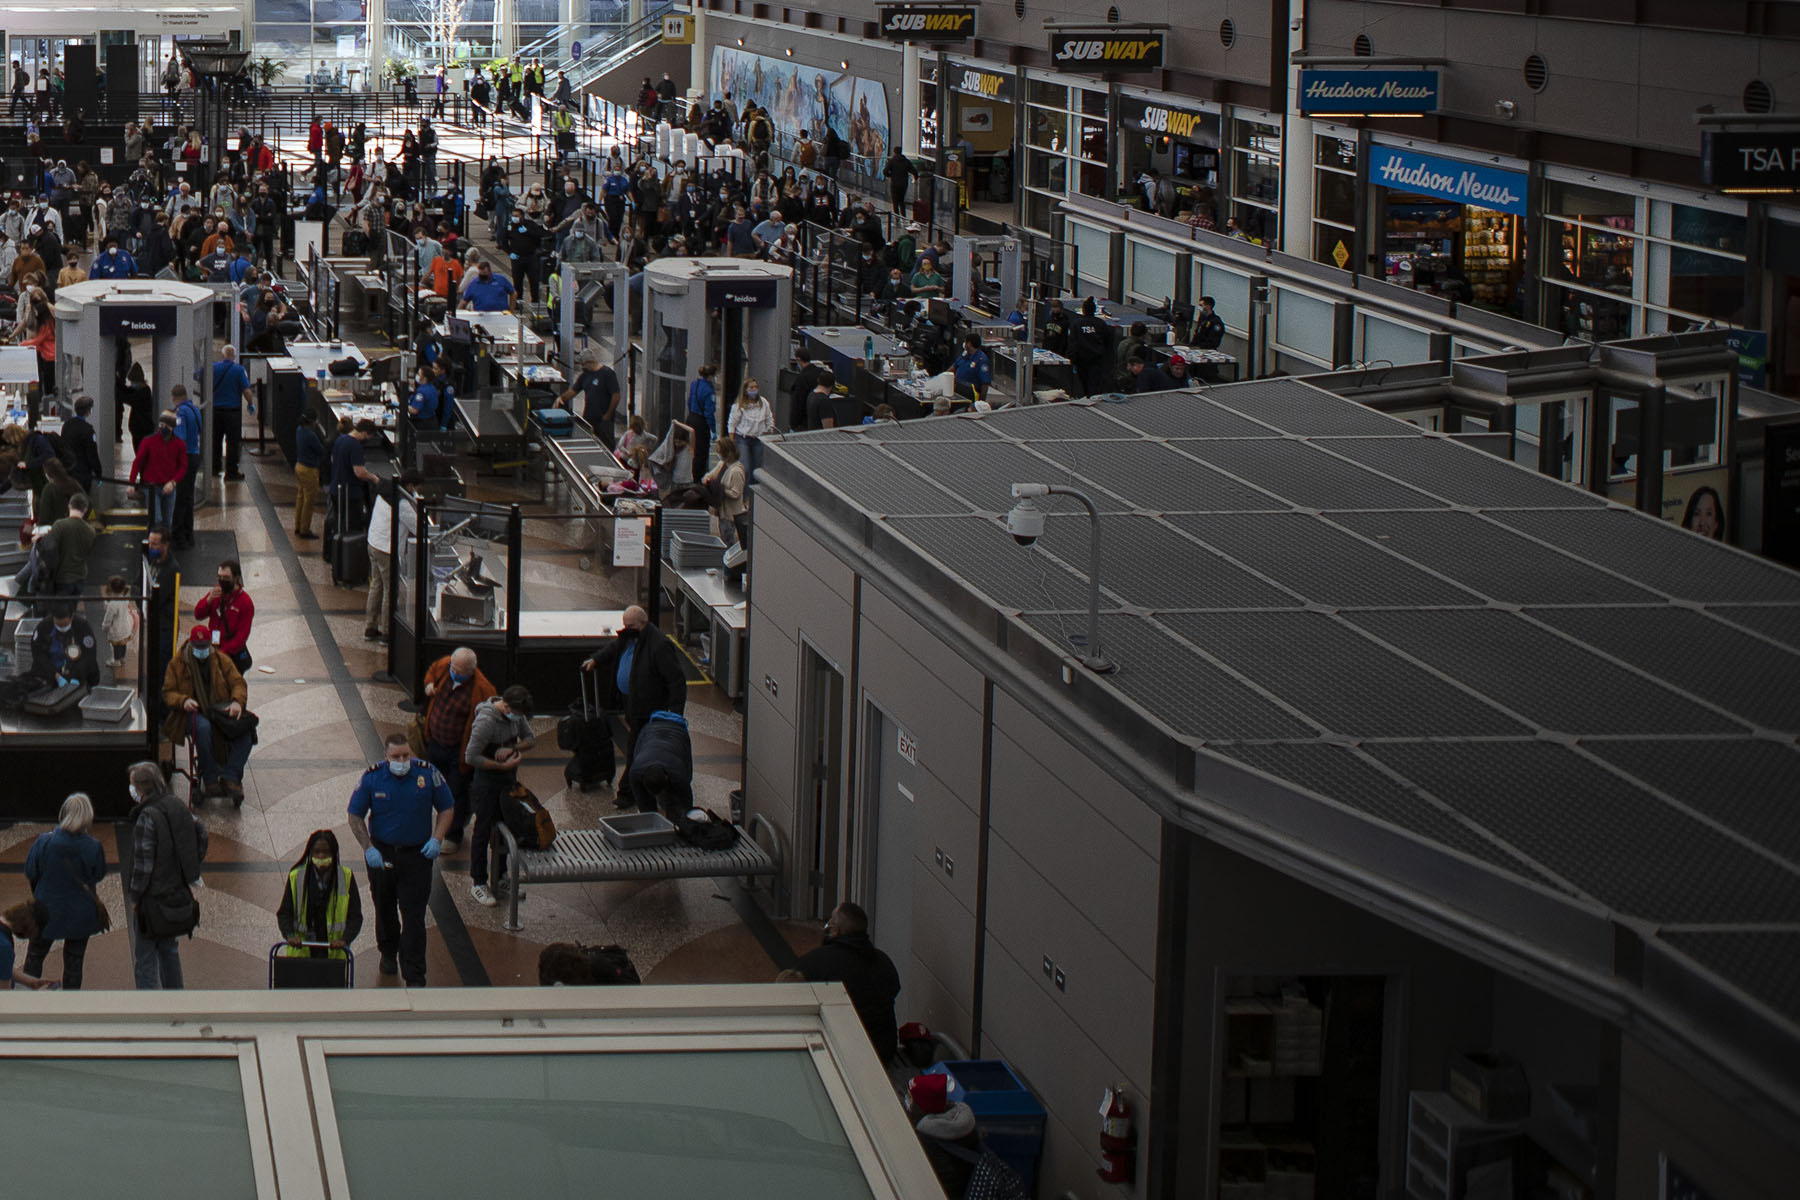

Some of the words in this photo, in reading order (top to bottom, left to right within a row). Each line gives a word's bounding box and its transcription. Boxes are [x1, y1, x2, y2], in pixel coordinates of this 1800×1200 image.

[884, 13, 973, 31] SUBWAY
[1056, 40, 1160, 60] SUBWAY
[961, 70, 1004, 96] SUBWAY
[1305, 80, 1378, 98] Hudson
[1377, 81, 1435, 98] News
[1139, 106, 1201, 137] SUBWAY
[1737, 147, 1785, 171] TSA
[1380, 155, 1454, 193] Hudson
[1455, 171, 1520, 205] News
[734, 295, 758, 303] leidos
[131, 321, 156, 330] leidos
[1081, 326, 1096, 334] TSA
[900, 737, 916, 761] EXIT
